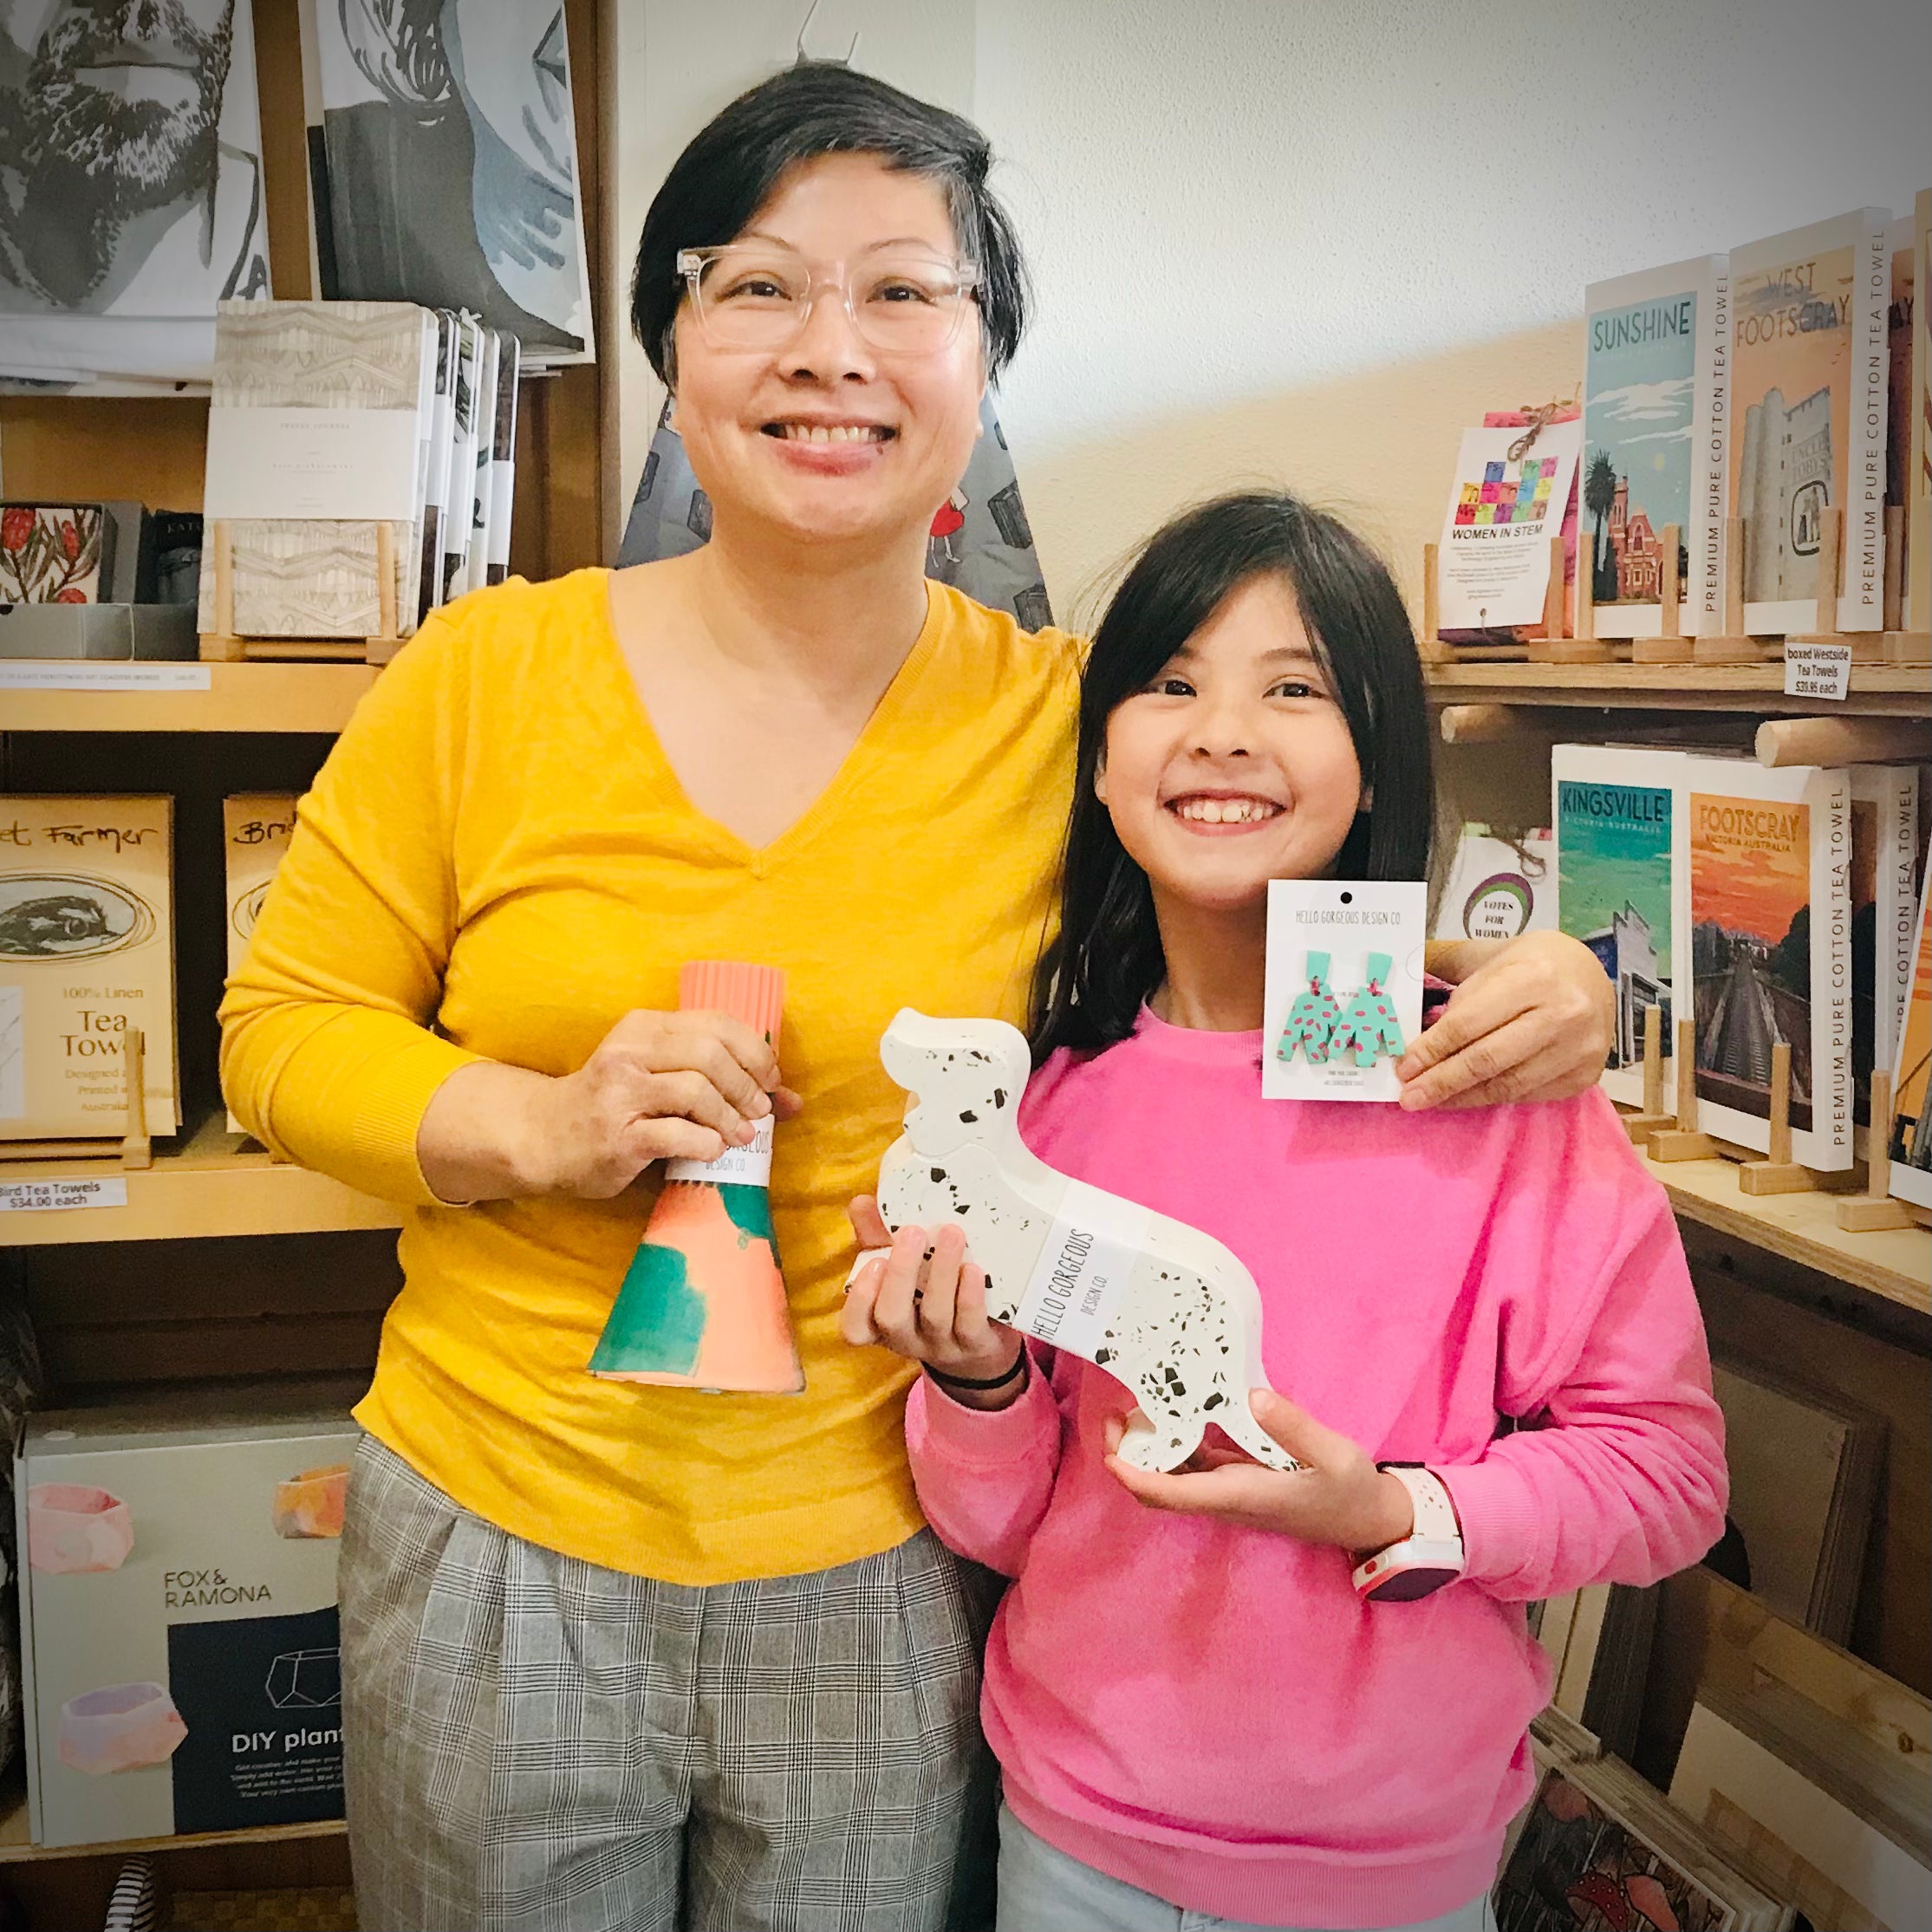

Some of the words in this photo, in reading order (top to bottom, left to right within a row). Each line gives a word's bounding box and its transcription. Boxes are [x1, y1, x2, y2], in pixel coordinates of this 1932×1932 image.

[1766, 262, 1817, 297] WEST
[1870, 231, 1884, 300] TOWEL
[1714, 273, 1728, 336] TOWEL
[1736, 294, 1850, 348] FOOTSCRAY
[1593, 301, 1691, 352] SUNSHINE
[1869, 309, 1882, 346] TEA
[1714, 345, 1726, 379] TEA
[1866, 355, 1881, 439] COTTON
[1710, 387, 1724, 463] COTTON
[1865, 449, 1878, 500] PURE
[1708, 471, 1721, 517] PURE
[1452, 529, 1498, 539] WOMEN
[1499, 527, 1512, 538] IN
[1513, 524, 1544, 537] STEM
[1705, 527, 1719, 612] PREMIUM
[1862, 511, 1877, 605] PREMIUM
[1787, 647, 1812, 659] boxed
[1813, 648, 1849, 660] Westside
[1797, 664, 1811, 675] Tea
[1812, 664, 1838, 677] Towels
[1819, 682, 1838, 693] each
[1562, 787, 1665, 823] KINGSVILLE
[1831, 787, 1844, 856] TOWEL
[1898, 785, 1912, 853] TOWEL
[42, 824, 159, 854] Farmer
[1700, 804, 1801, 842] FOOTSCRAY
[1744, 839, 1791, 853] AUSTRALIA
[1831, 863, 1844, 901] TEA
[1898, 863, 1911, 898] TEA
[1296, 910, 1318, 924] HELLO
[1321, 910, 1360, 925] GORGEOUS
[1362, 911, 1389, 925] DESIGN
[1390, 912, 1401, 926] CO
[1483, 901, 1513, 910] VOTES
[1485, 915, 1505, 925] FOR
[1475, 929, 1509, 939] WOMEN
[1831, 908, 1844, 988] COTTON
[1896, 906, 1910, 986] COTTON
[105, 987, 144, 999] Linen
[77, 1010, 127, 1032] Tea
[1832, 998, 1845, 1046] PURE
[60, 1031, 146, 1057] Towl
[65, 1067, 119, 1081] Designed
[78, 1083, 119, 1096] Printed
[1832, 1056, 1846, 1146] PREMIUM
[10, 1196, 52, 1208] $34.00
[55, 1194, 88, 1207] each
[25, 1186, 49, 1196] Tea
[53, 1181, 101, 1194] Towels
[1030, 1297, 1066, 1341] HELLO
[1048, 1228, 1095, 1298] GORGEOUS
[1080, 1287, 1103, 1317] DESIGN
[165, 1584, 273, 1609] RAMONA
[231, 1730, 276, 1753] DIY
